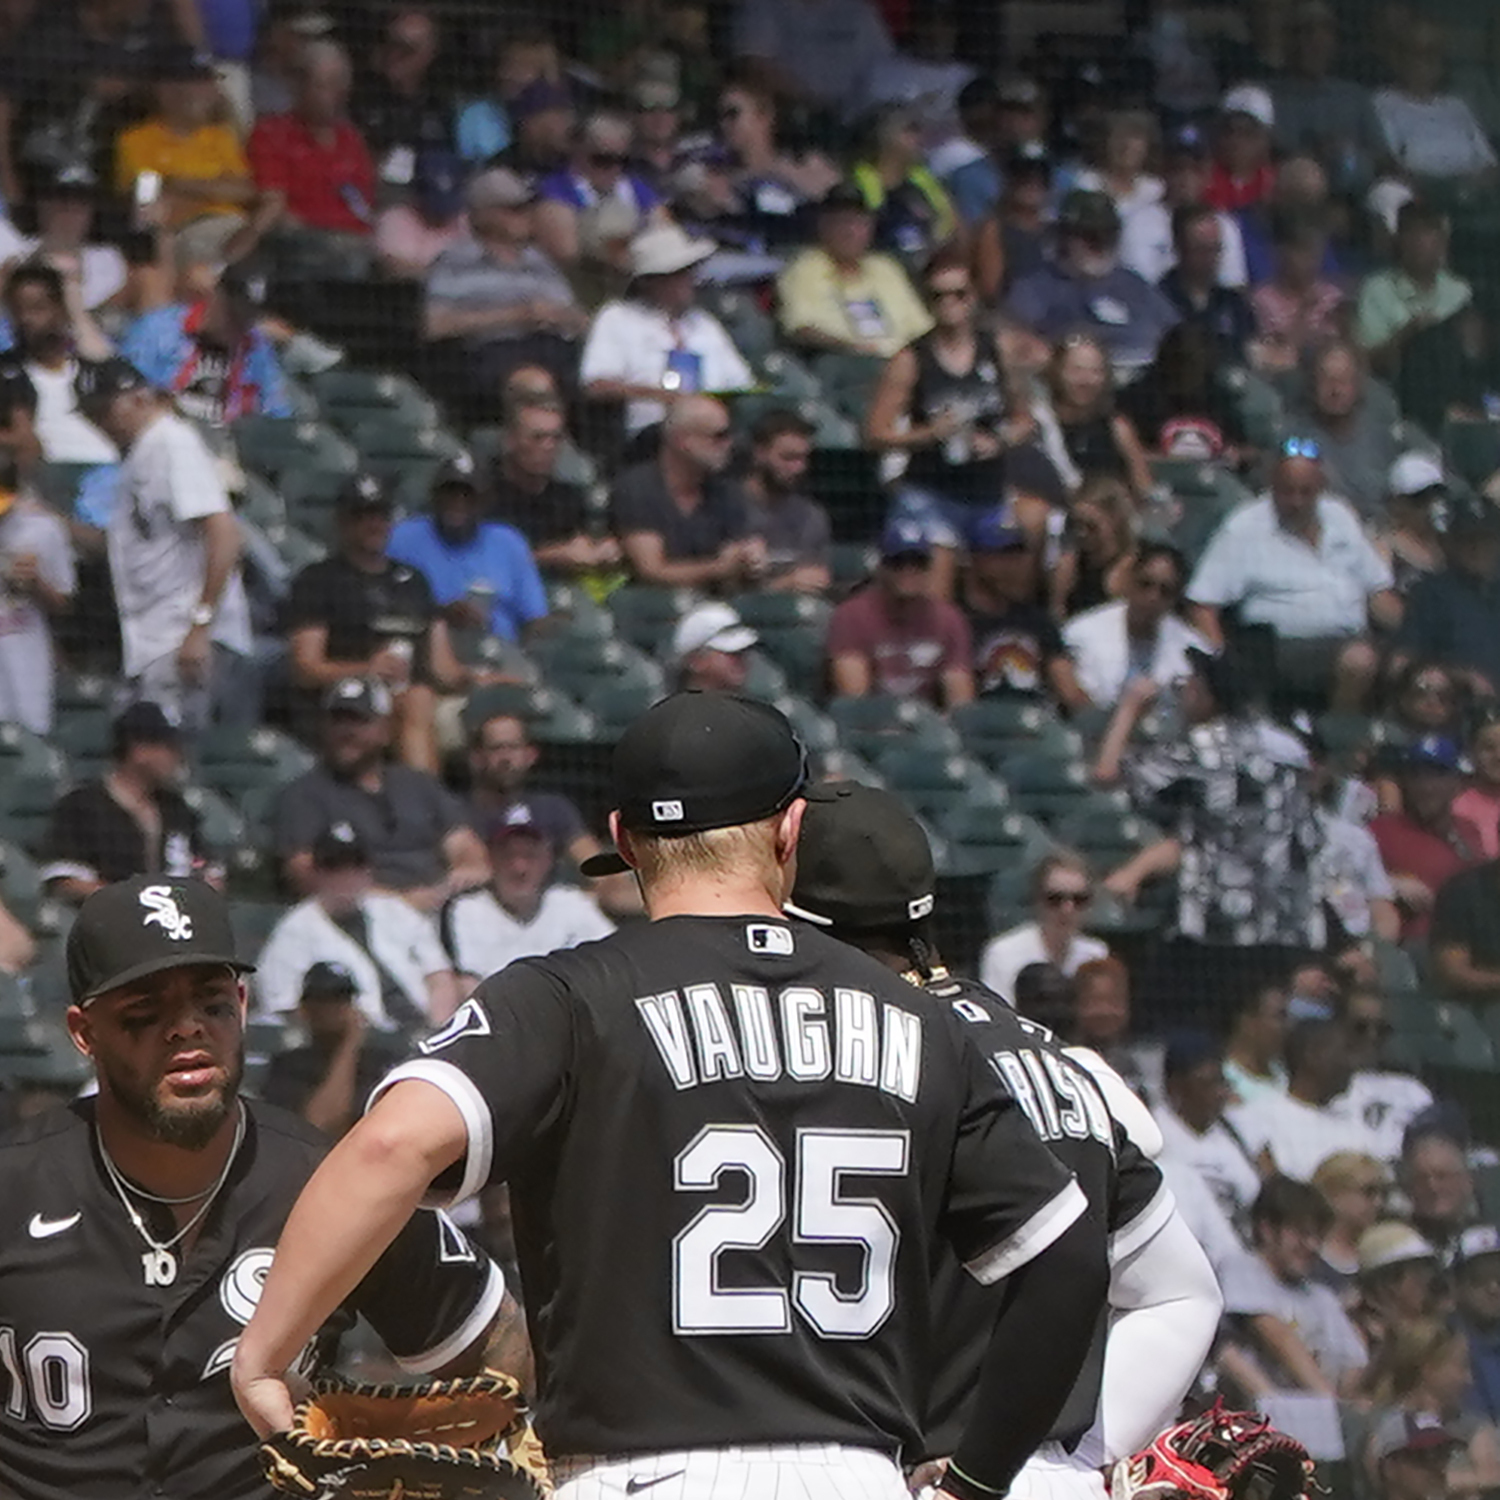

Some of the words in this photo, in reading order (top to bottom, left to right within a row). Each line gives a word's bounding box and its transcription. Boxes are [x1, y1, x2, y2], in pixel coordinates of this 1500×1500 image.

[139, 885, 193, 940] Sox
[634, 982, 923, 1104] VAUGHN
[142, 1252, 177, 1286] 10
[672, 1123, 912, 1340] 25
